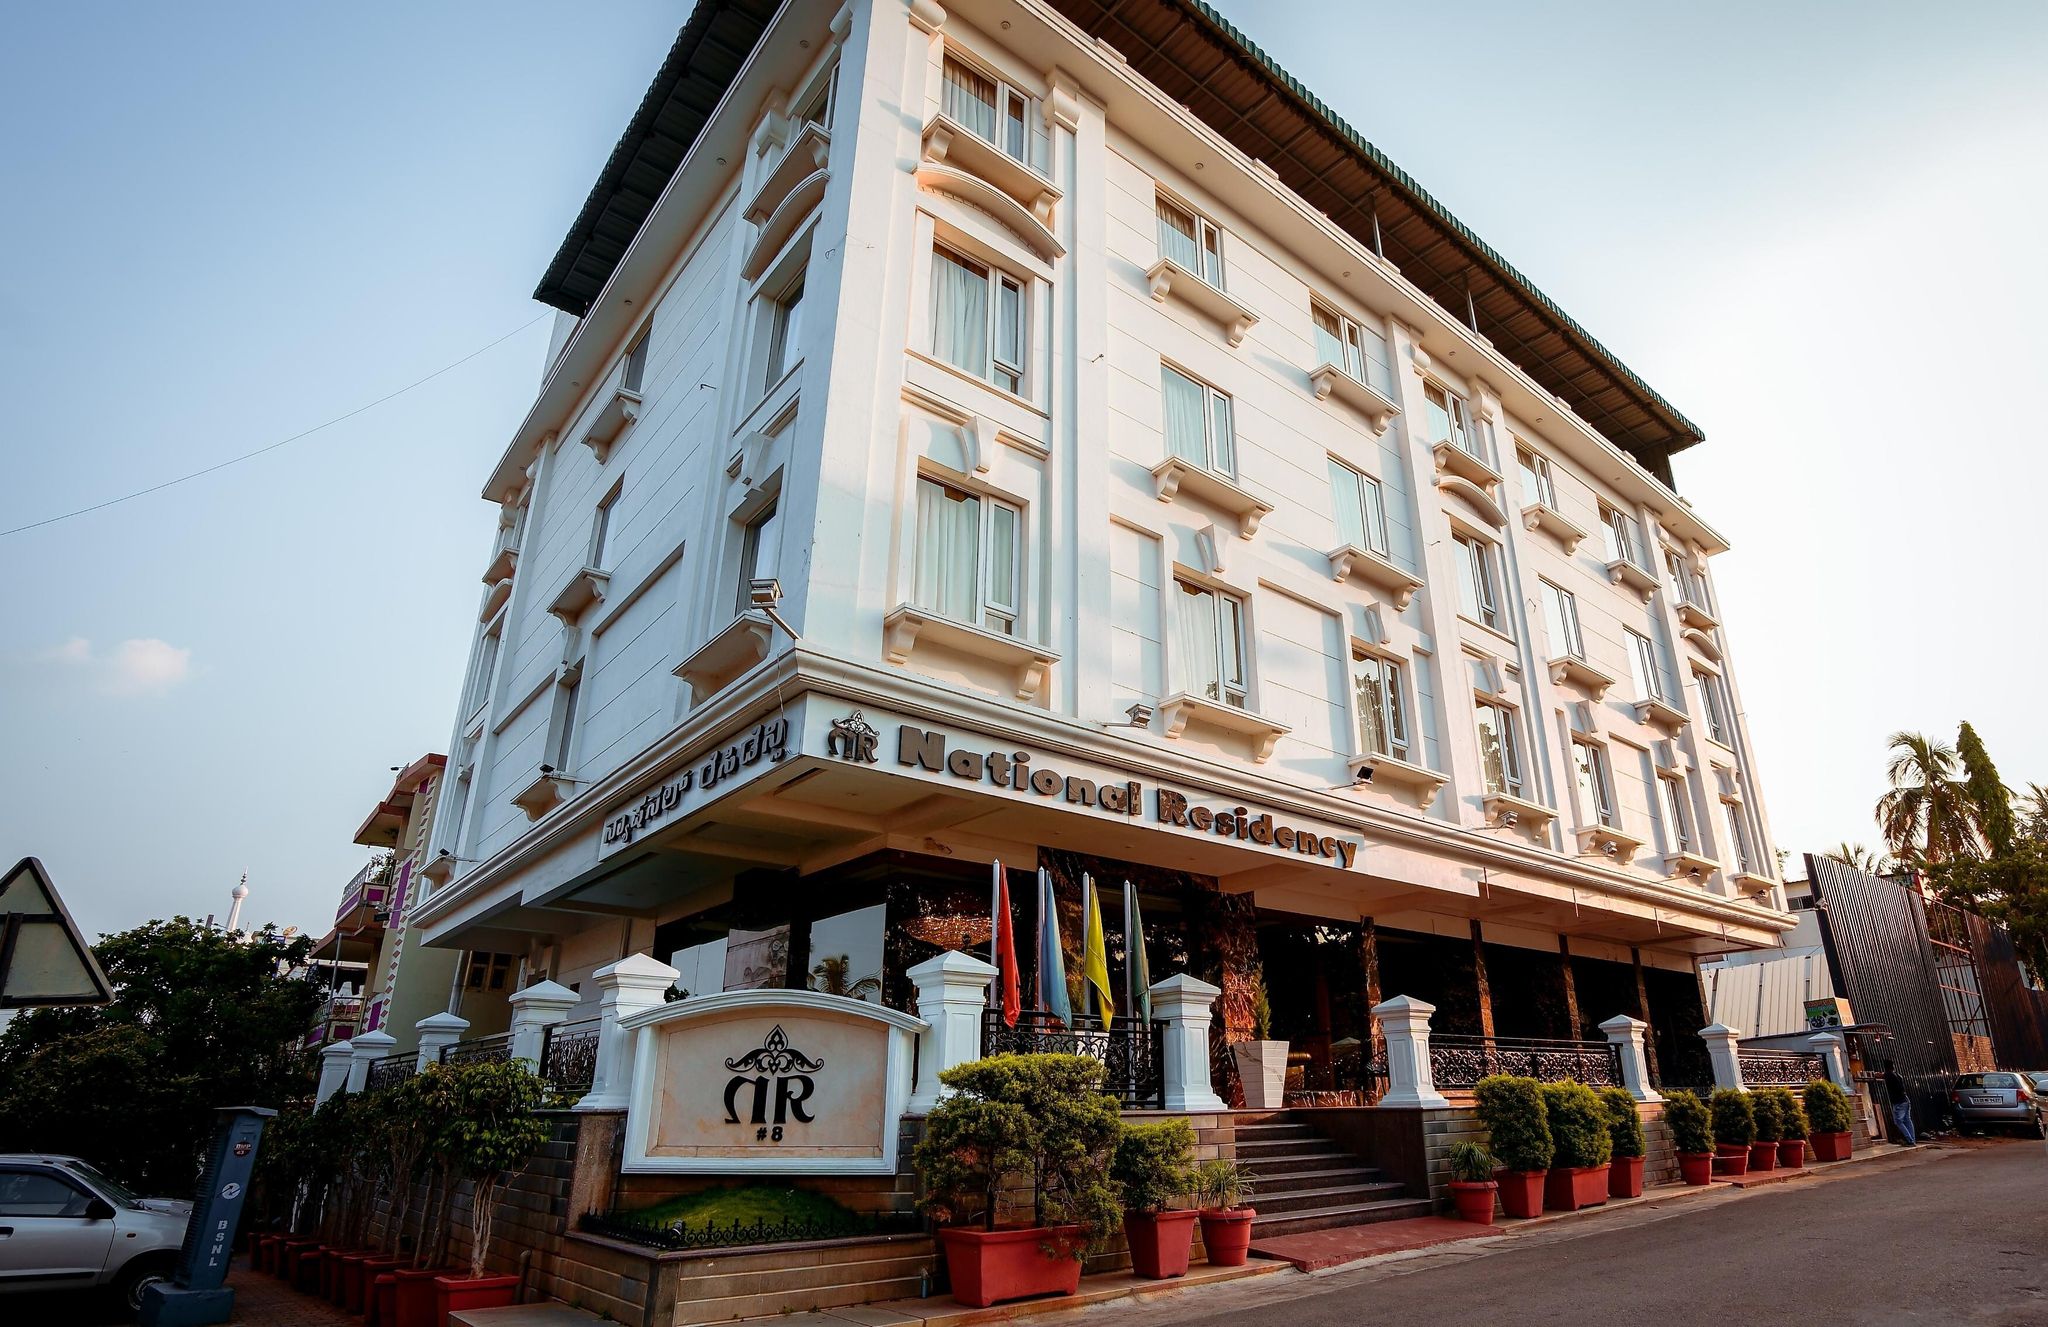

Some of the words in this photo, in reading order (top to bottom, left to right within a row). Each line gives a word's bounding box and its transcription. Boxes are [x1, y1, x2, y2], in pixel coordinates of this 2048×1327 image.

[899, 724, 1142, 816] National
[1157, 788, 1358, 869] Residency
[208, 1220, 229, 1267] BSNL
